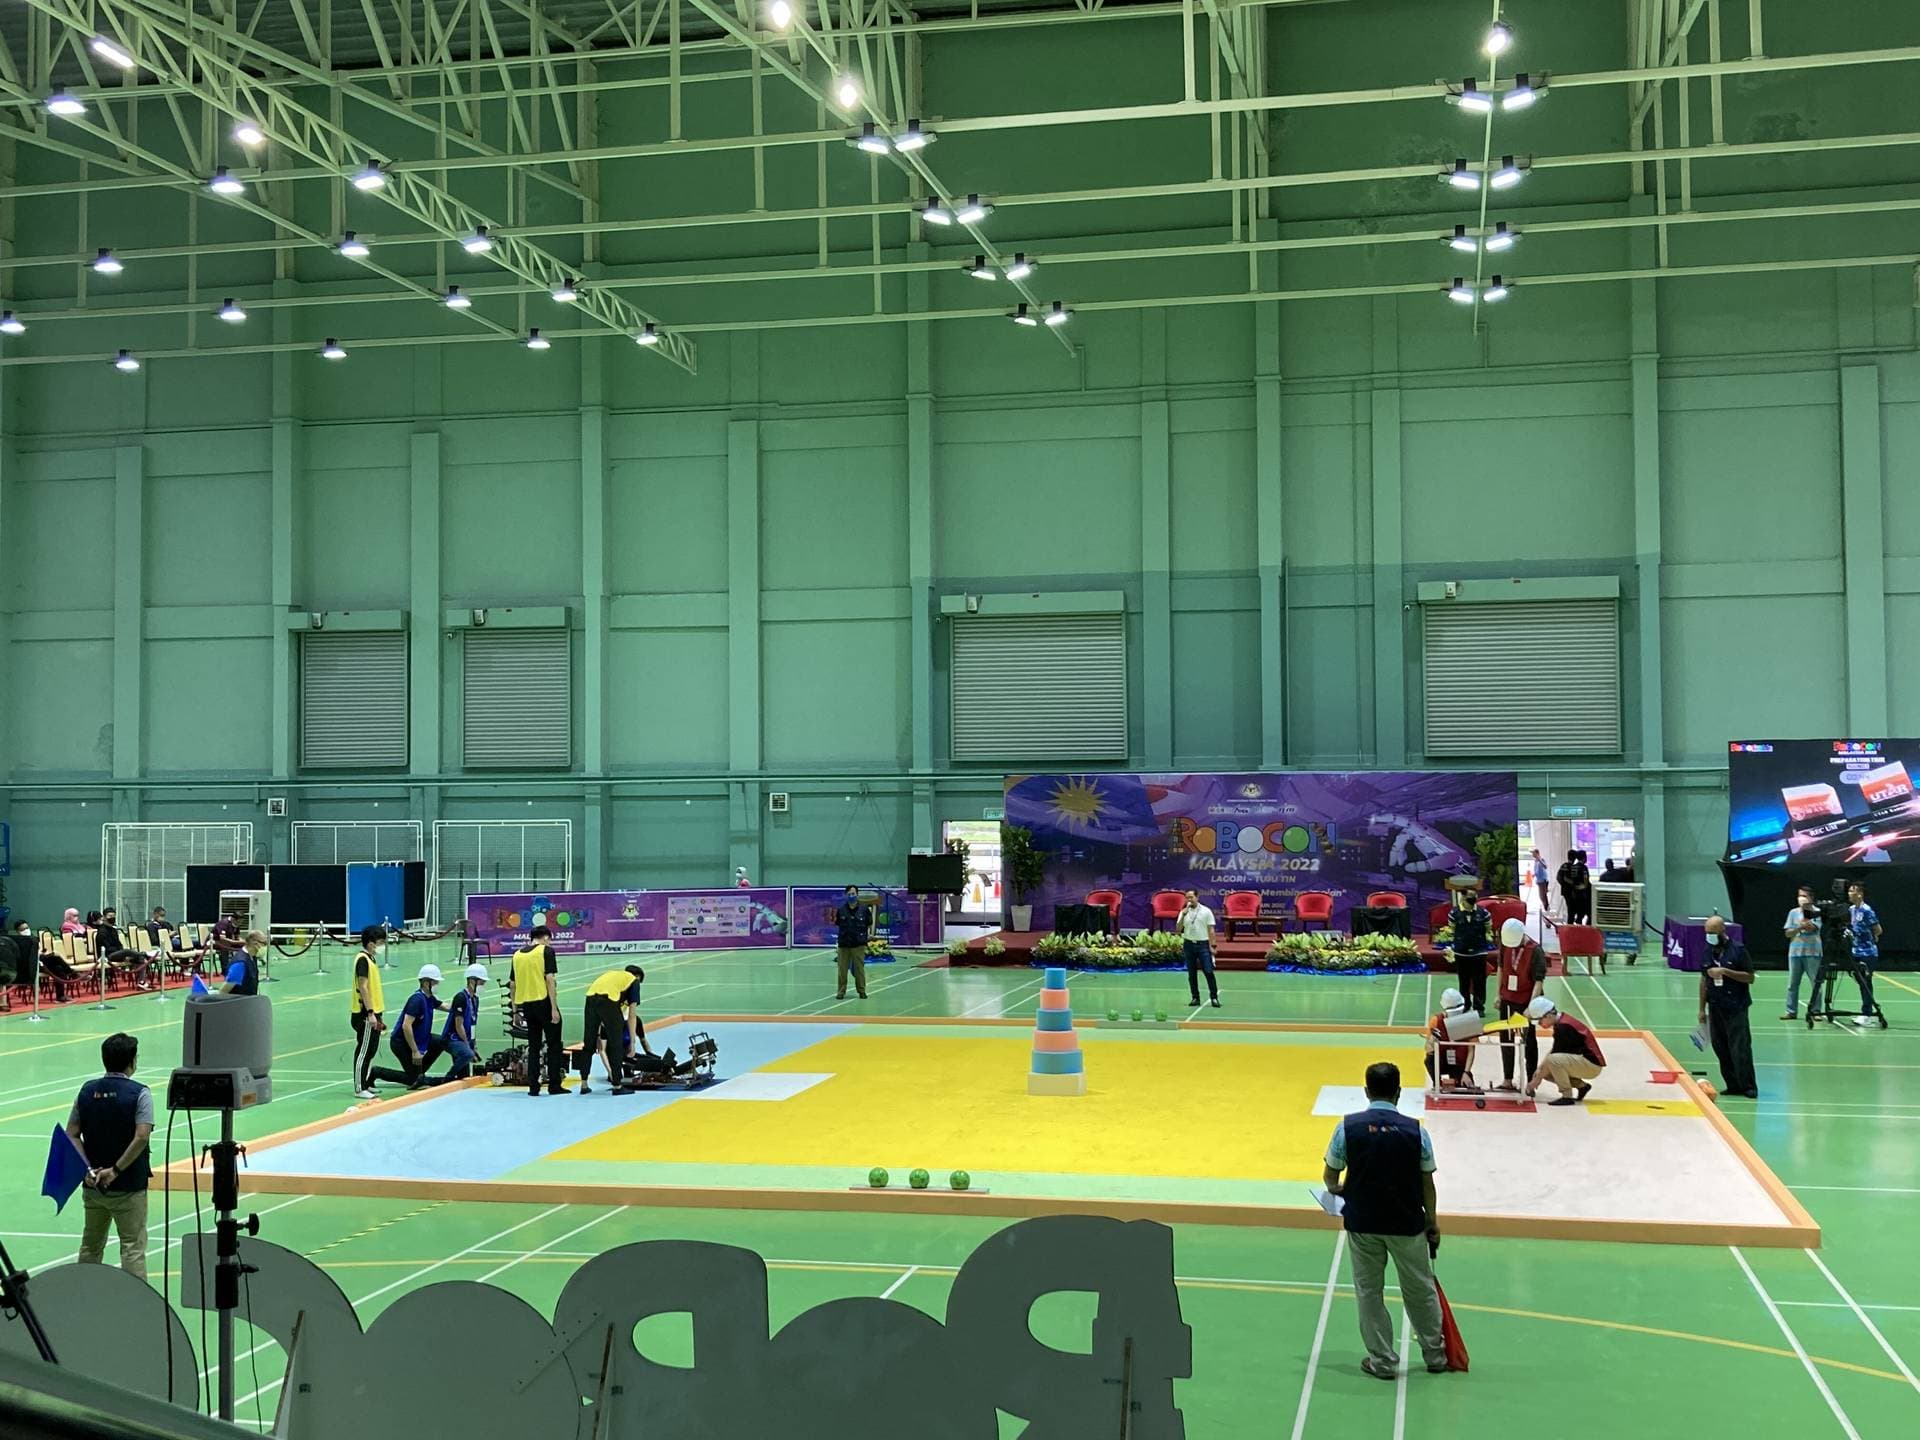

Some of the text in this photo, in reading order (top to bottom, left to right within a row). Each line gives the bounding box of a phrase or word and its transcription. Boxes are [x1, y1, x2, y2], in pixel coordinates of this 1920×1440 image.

[1188, 857, 1321, 871] MALAYSIA 2022
[1211, 875, 1246, 883] LAGORI
[555, 932, 575, 940] 2022
